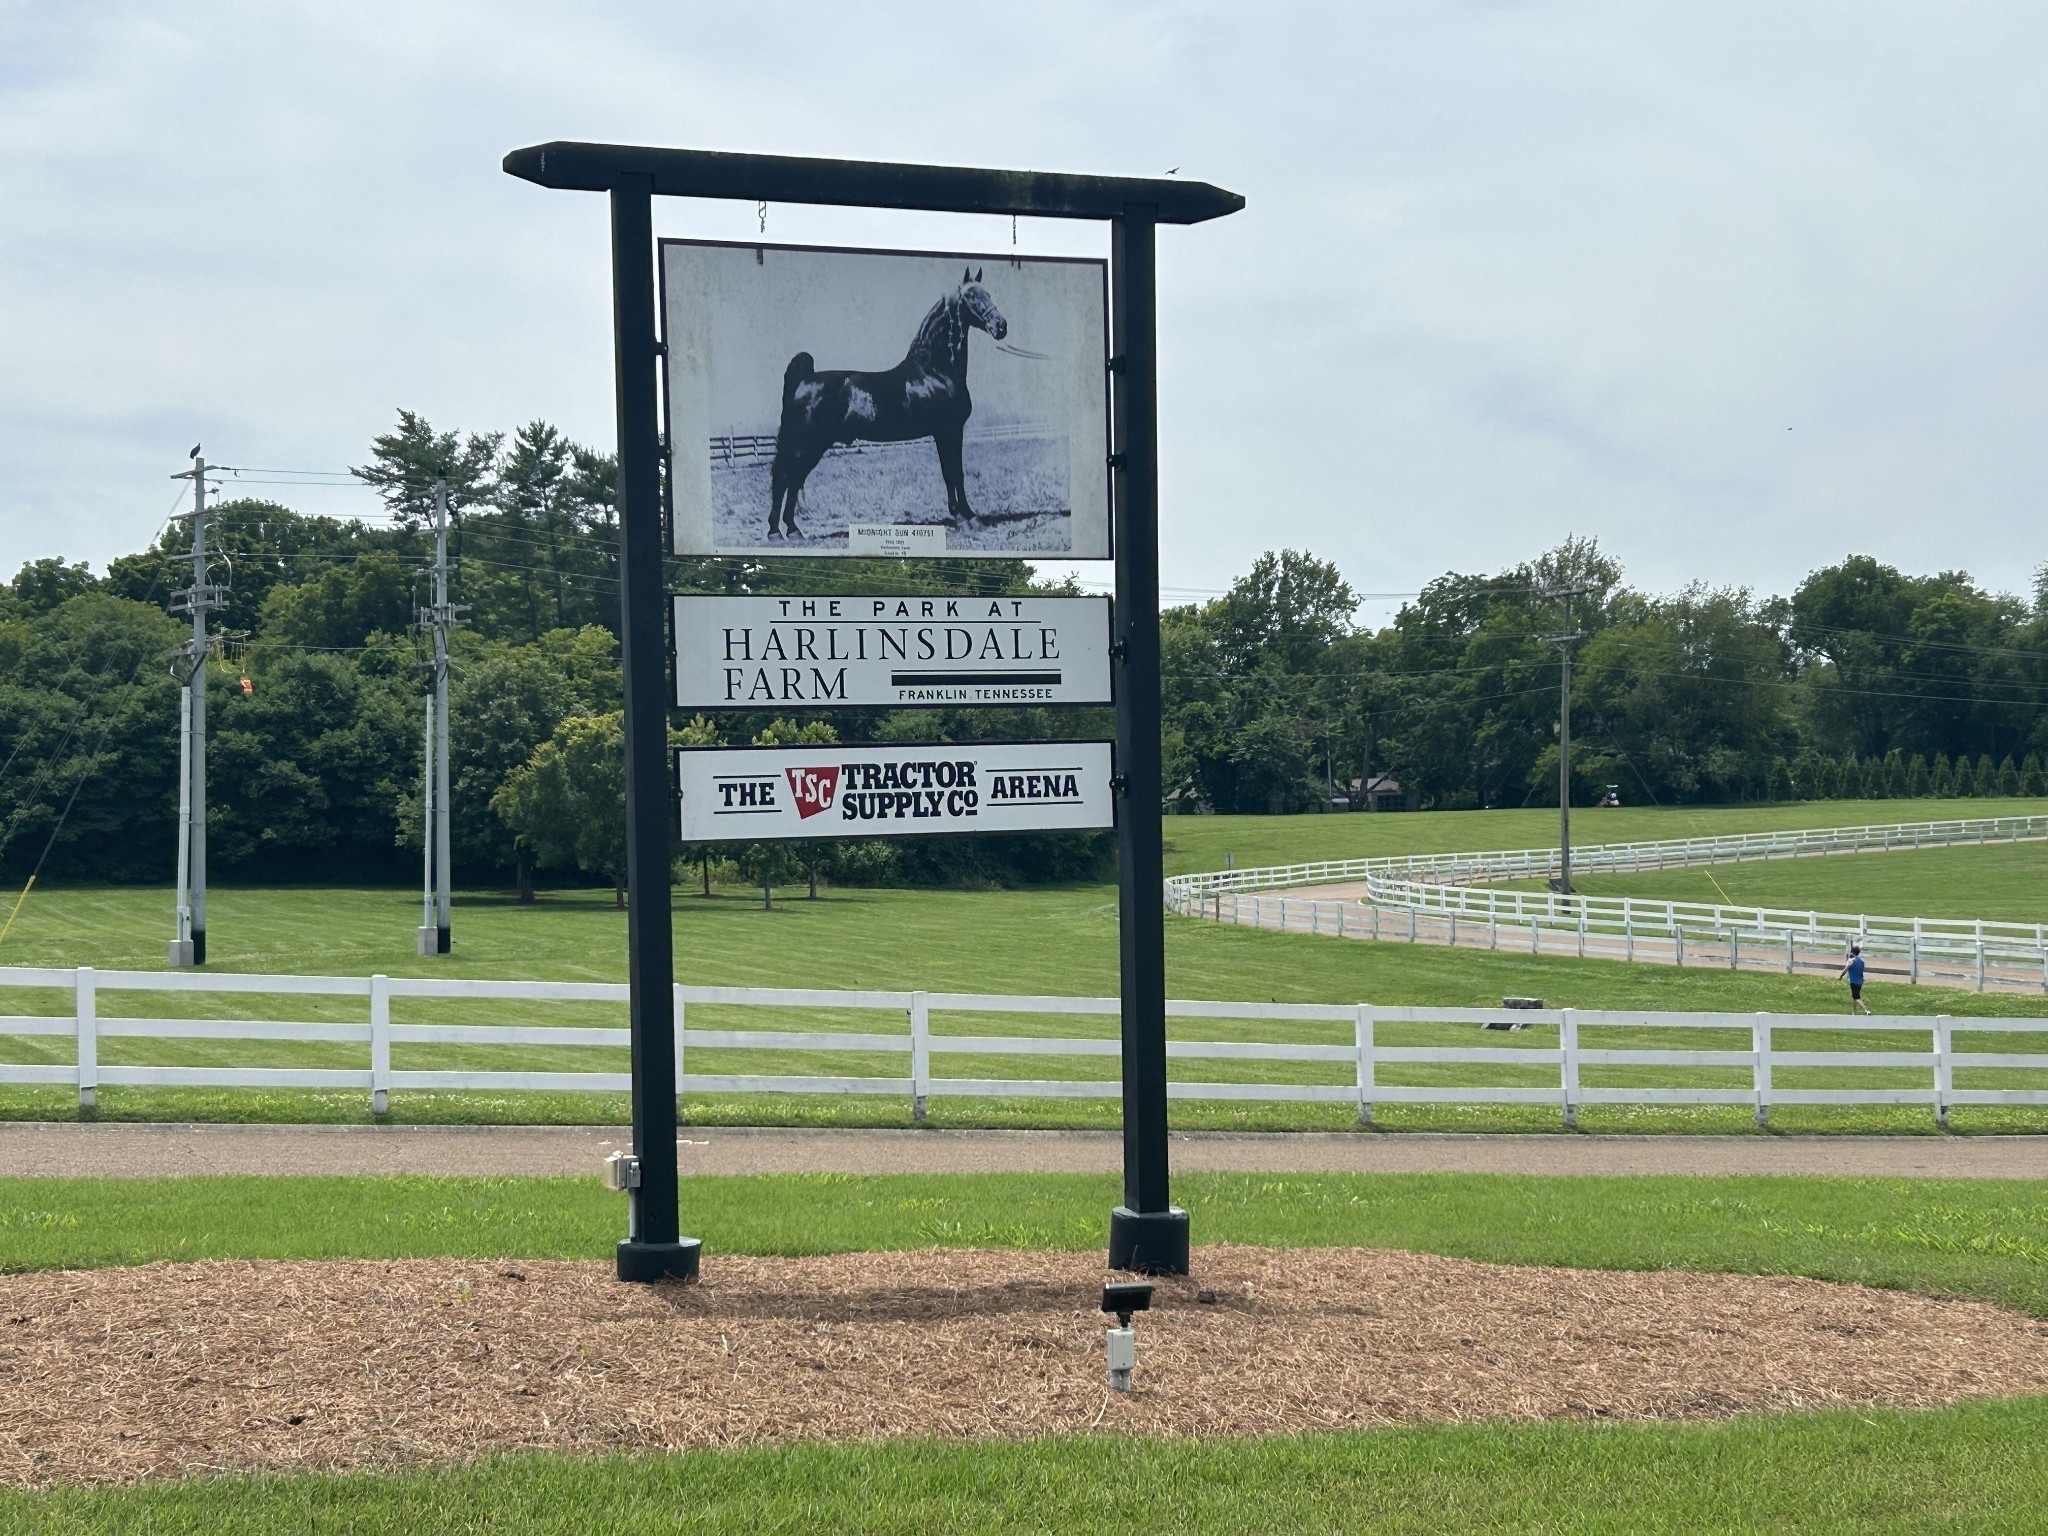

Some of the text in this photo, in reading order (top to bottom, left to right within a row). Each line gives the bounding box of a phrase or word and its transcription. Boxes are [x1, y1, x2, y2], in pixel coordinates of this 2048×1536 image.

[779, 600, 1023, 617] THE PARK AT
[722, 628, 1061, 661] HARLINSDALE
[723, 667, 849, 701] FARM
[975, 688, 1053, 699] TENNESSEE
[791, 768, 831, 809] TSC
[842, 761, 977, 790] TRACTOR
[990, 774, 1080, 799] ARENA
[718, 781, 775, 807] THE
[842, 791, 944, 820] SUPPLY
